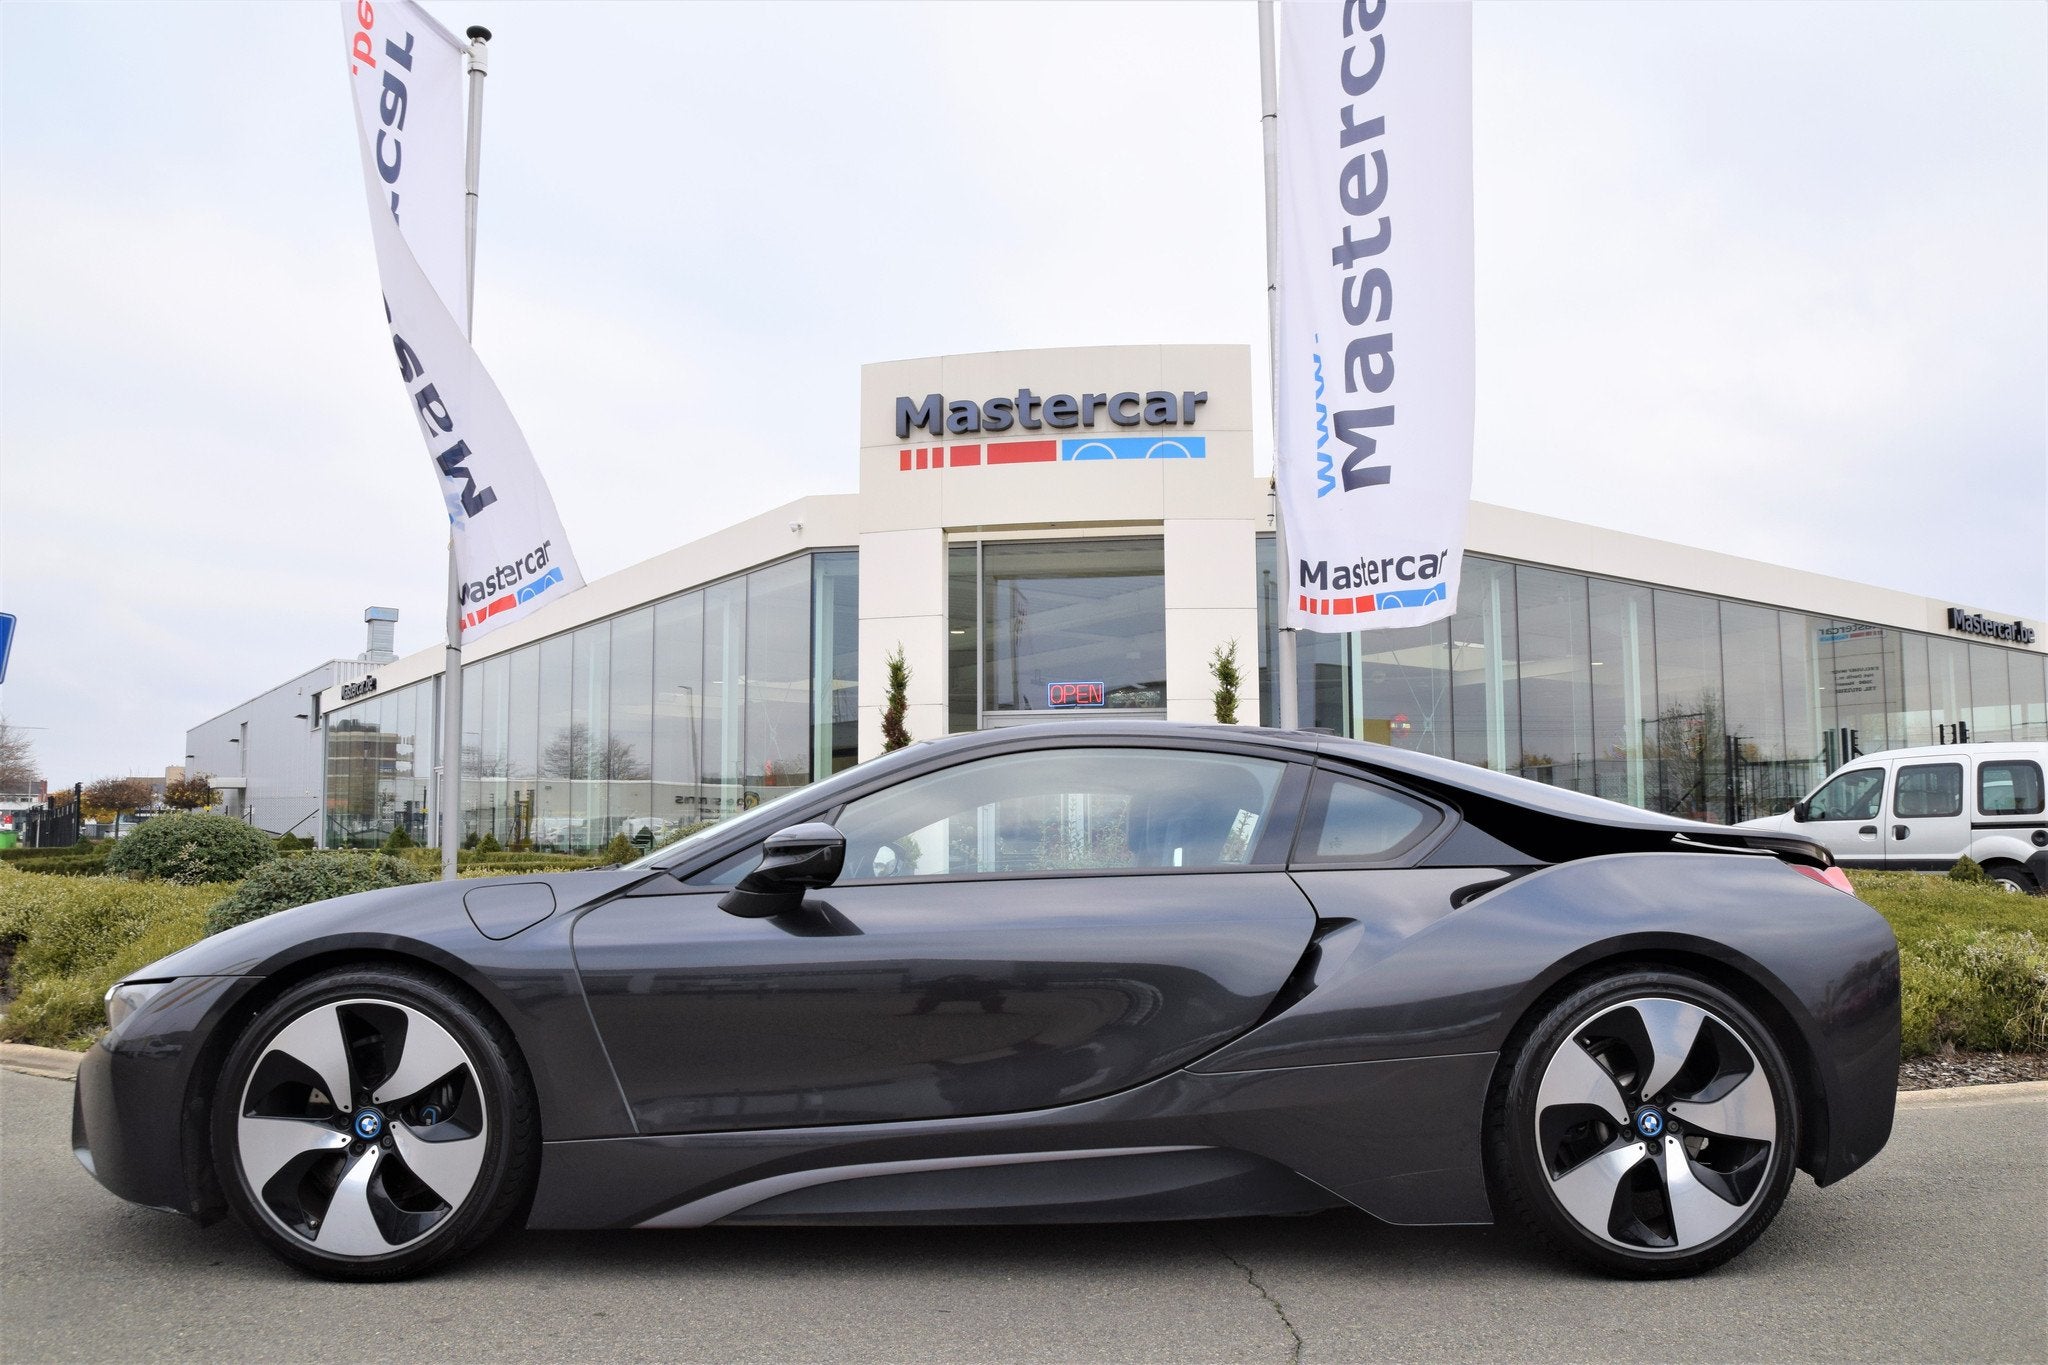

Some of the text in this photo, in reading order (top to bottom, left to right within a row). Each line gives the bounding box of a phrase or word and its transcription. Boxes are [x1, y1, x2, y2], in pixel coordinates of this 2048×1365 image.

[1331, 0, 1395, 492] Masterca
[384, 291, 498, 518] Mas
[896, 388, 1208, 438] Mastercar
[1299, 548, 1448, 591] Mastercar
[1947, 607, 2035, 643] Mastercar.be
[1051, 685, 1102, 704] OPEN
